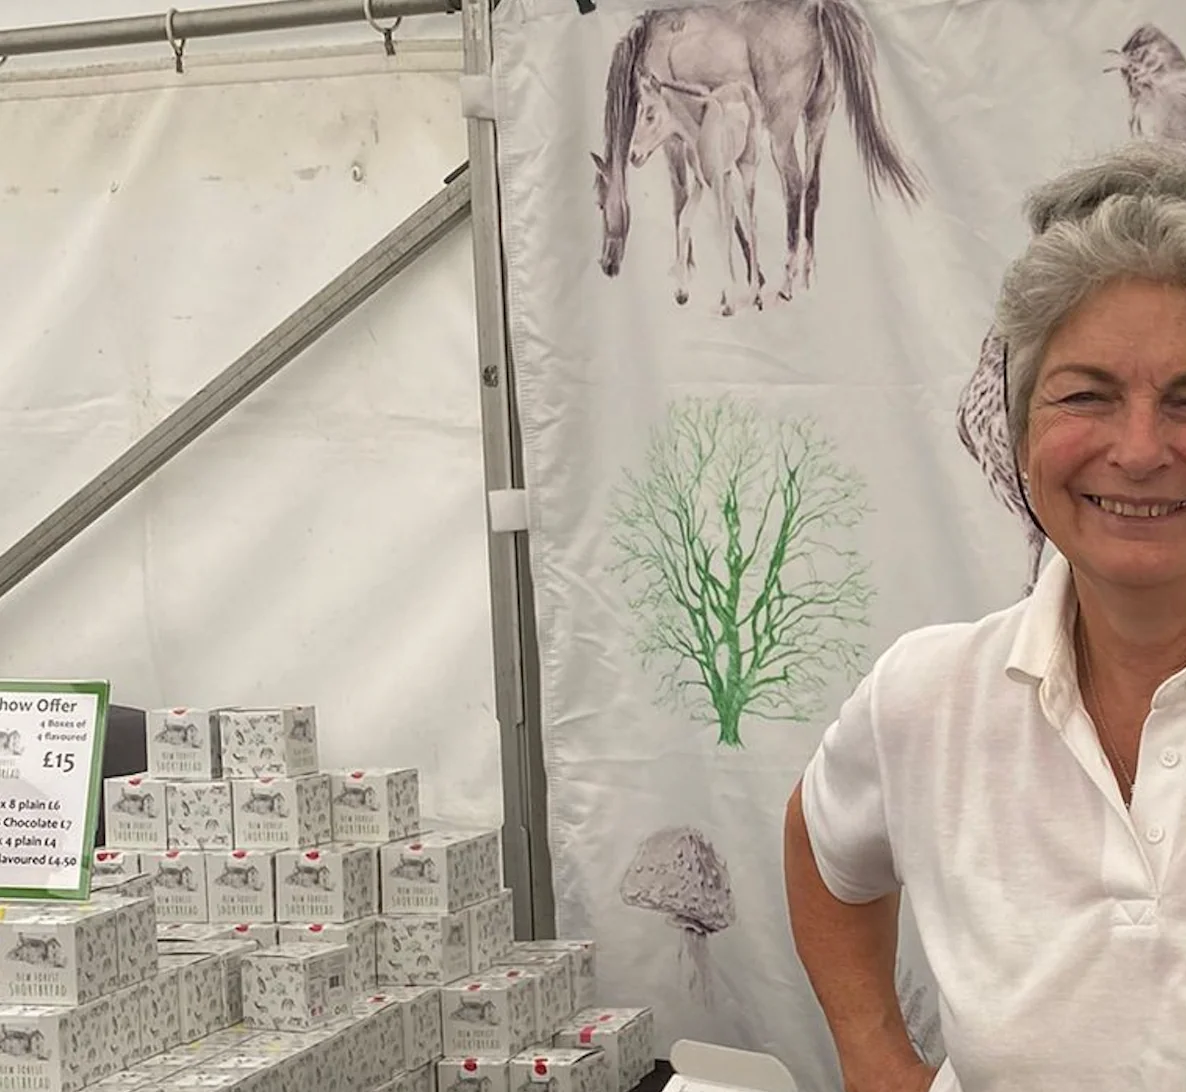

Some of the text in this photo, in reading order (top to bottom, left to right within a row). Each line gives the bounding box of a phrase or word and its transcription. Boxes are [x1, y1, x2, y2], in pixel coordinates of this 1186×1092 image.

[37, 698, 78, 712] Offer
[48, 719, 74, 727] Boxes
[76, 720, 87, 728] of
[44, 732, 87, 741] flavoured
[43, 751, 75, 773] £15
[9, 799, 15, 809] 8
[18, 800, 45, 811] plain
[48, 801, 60, 810] £6
[3, 817, 72, 830] Chocolate £7
[5, 836, 56, 848] 4 plain £4
[48, 856, 77, 867] £4.50
